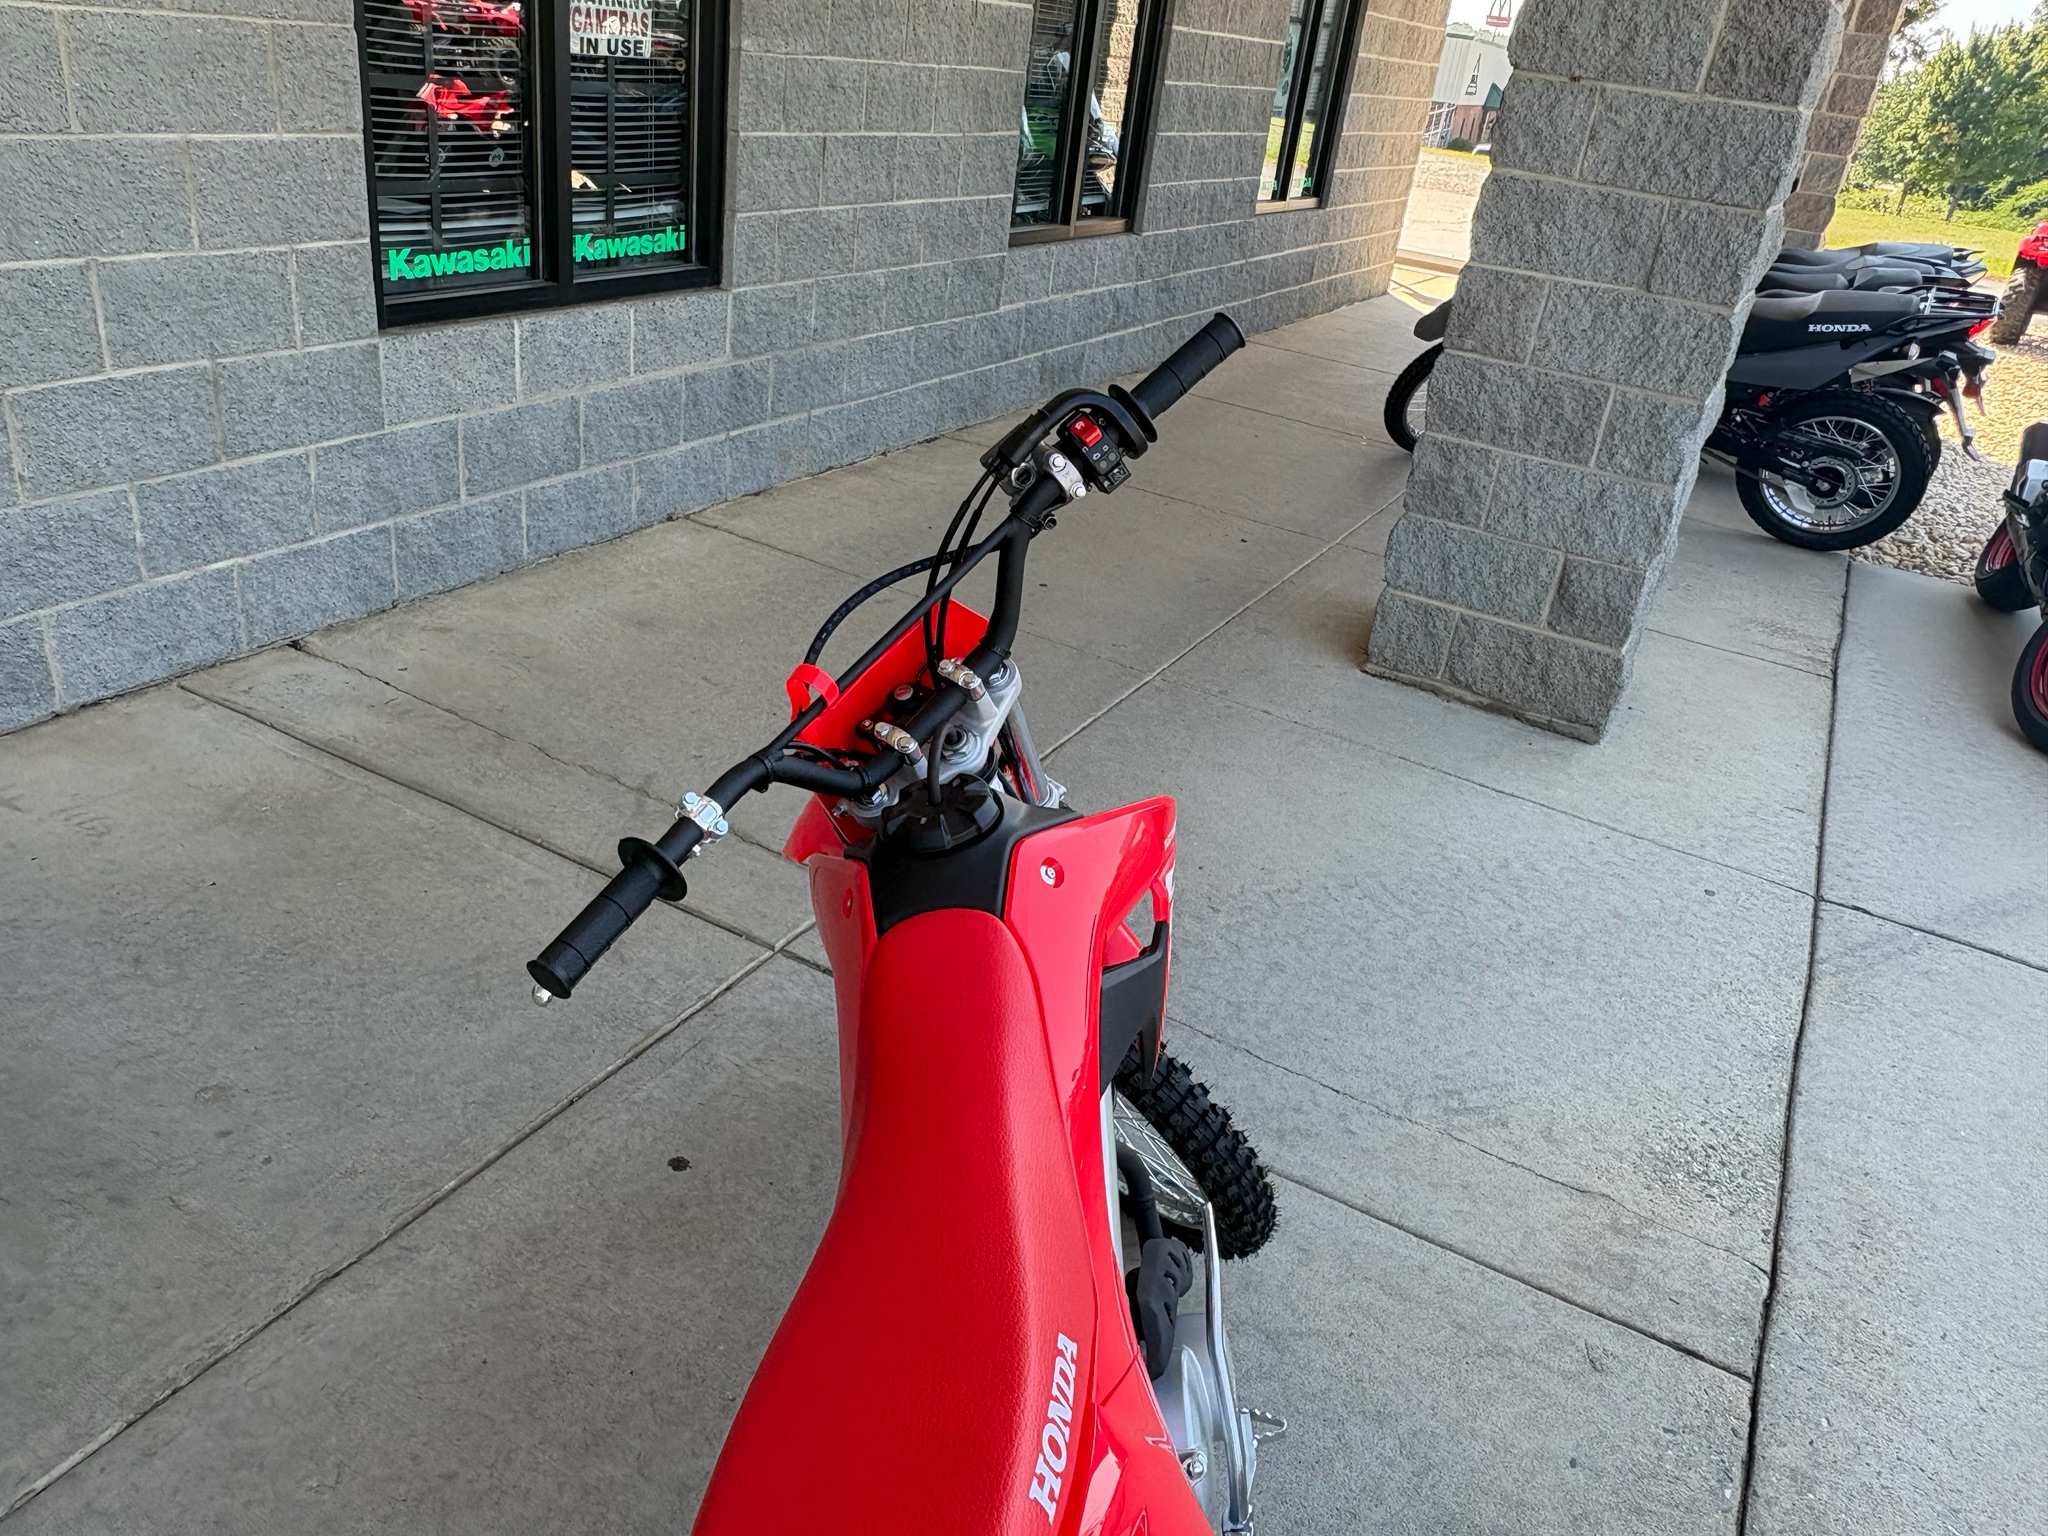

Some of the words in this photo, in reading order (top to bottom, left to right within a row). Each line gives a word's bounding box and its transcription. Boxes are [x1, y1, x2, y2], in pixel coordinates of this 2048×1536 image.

[580, 36, 599, 54] IN
[607, 38, 644, 57] USE
[388, 238, 531, 281] Kawasaki
[575, 225, 686, 262] Kawasaki
[1808, 323, 1872, 333] HONDA
[1028, 1332, 1078, 1526] HONDA
